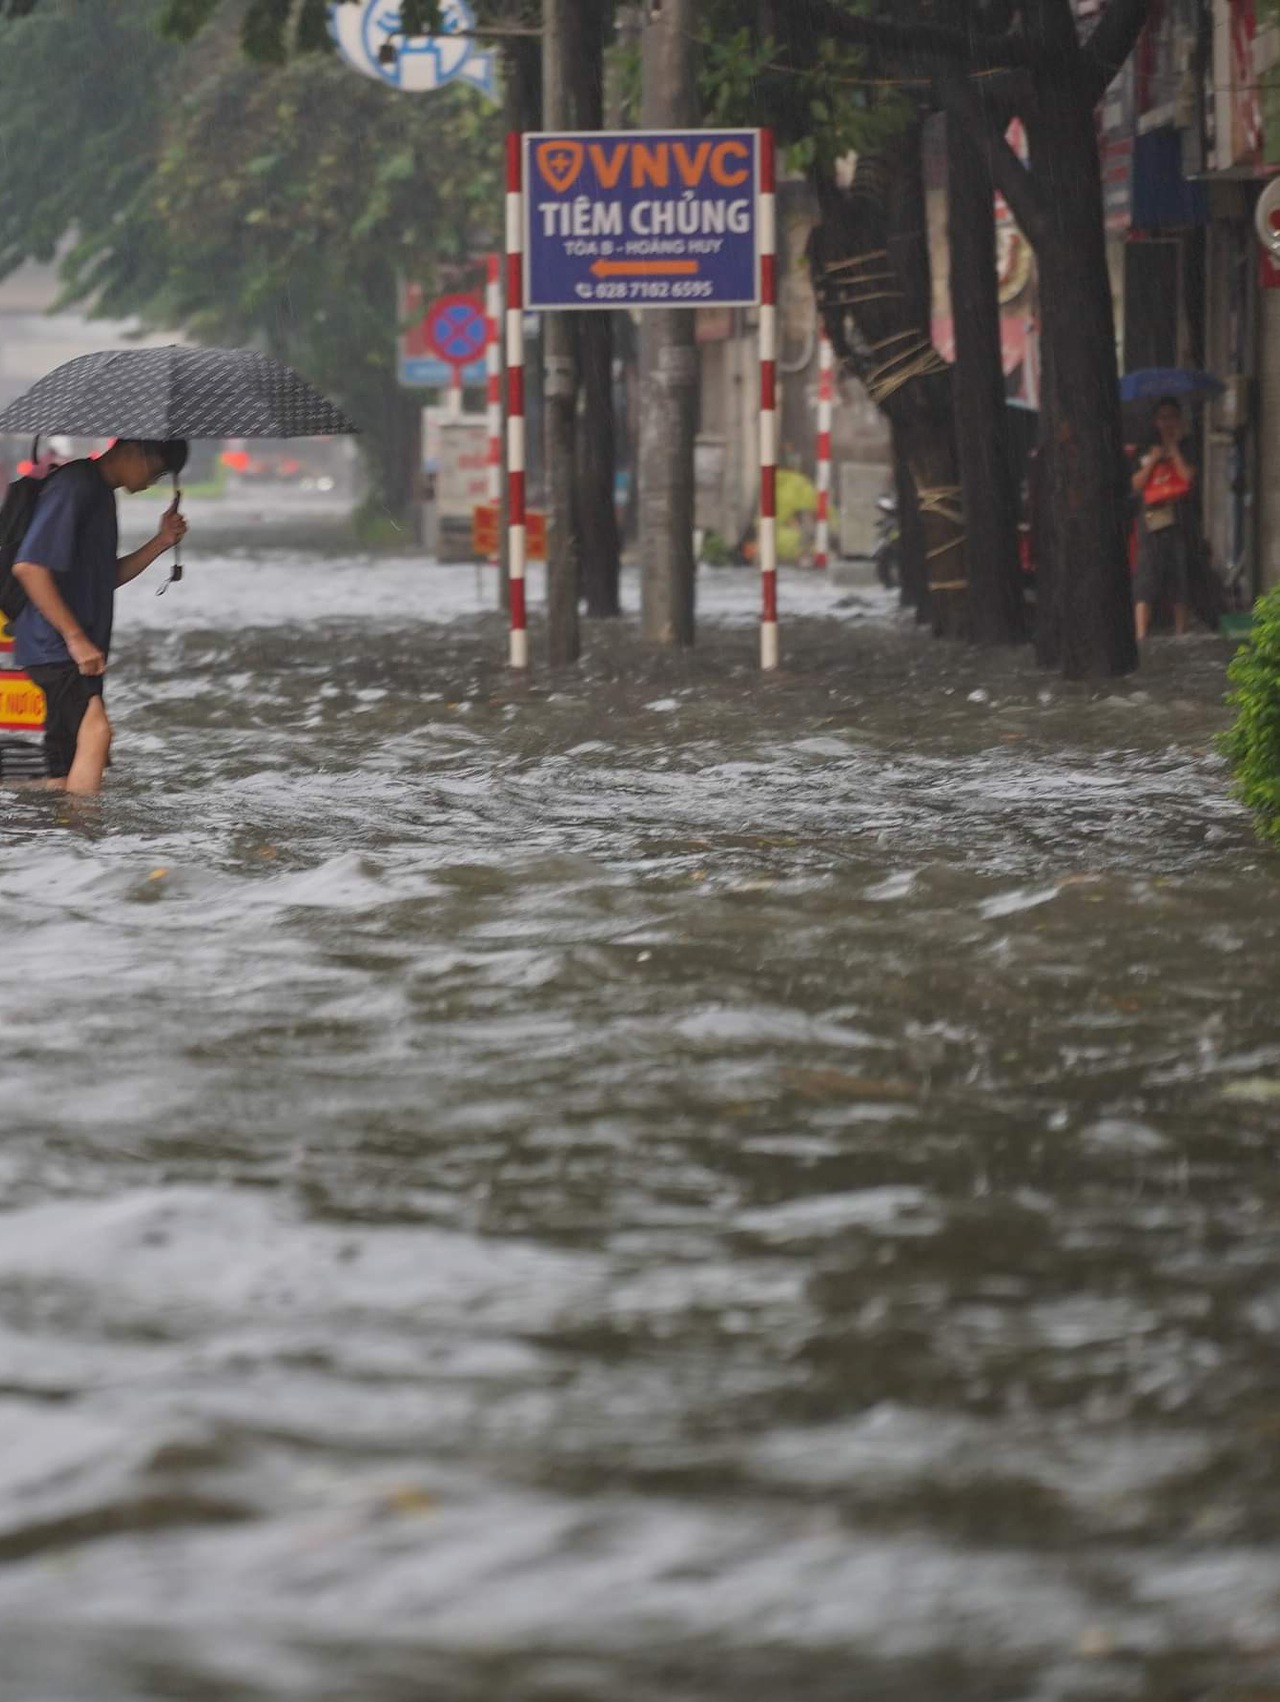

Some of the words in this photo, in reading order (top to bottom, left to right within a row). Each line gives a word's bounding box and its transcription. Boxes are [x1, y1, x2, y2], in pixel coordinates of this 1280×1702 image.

[588, 140, 749, 189] VNVC
[538, 195, 623, 237] TIÊM
[630, 190, 750, 236] CHỦNG
[688, 238, 724, 254] HUY
